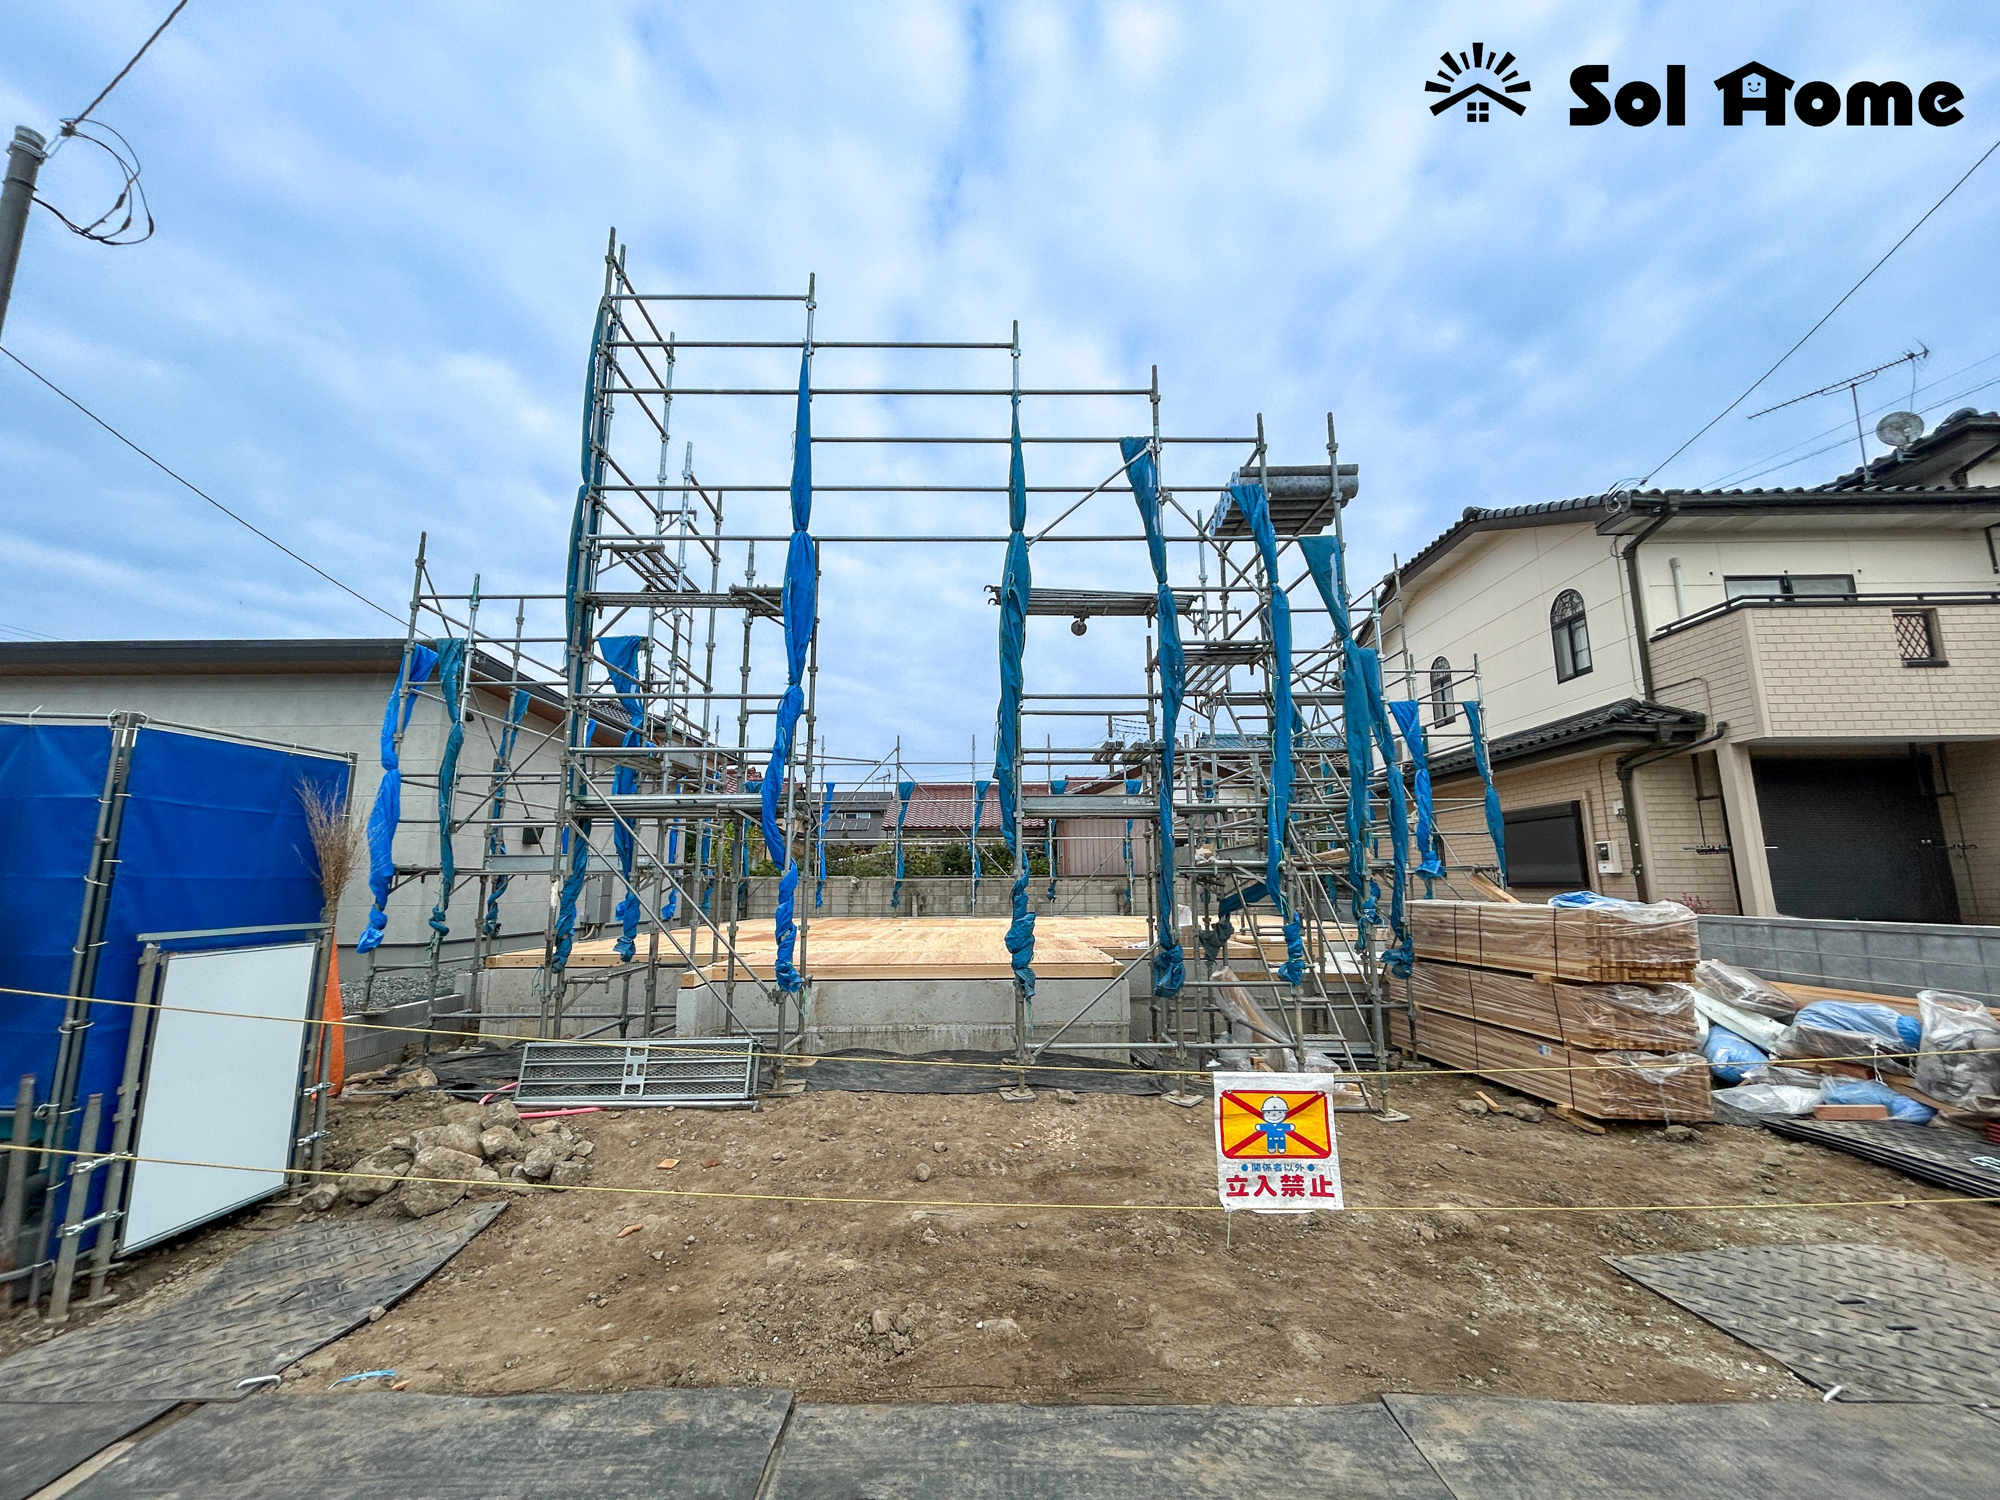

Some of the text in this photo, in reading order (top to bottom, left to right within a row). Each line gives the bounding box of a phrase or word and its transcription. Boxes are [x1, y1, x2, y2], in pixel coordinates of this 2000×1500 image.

[1251, 1163, 1305, 1172] 関係者以外
[1226, 1174, 1335, 1198] 立入禁止
